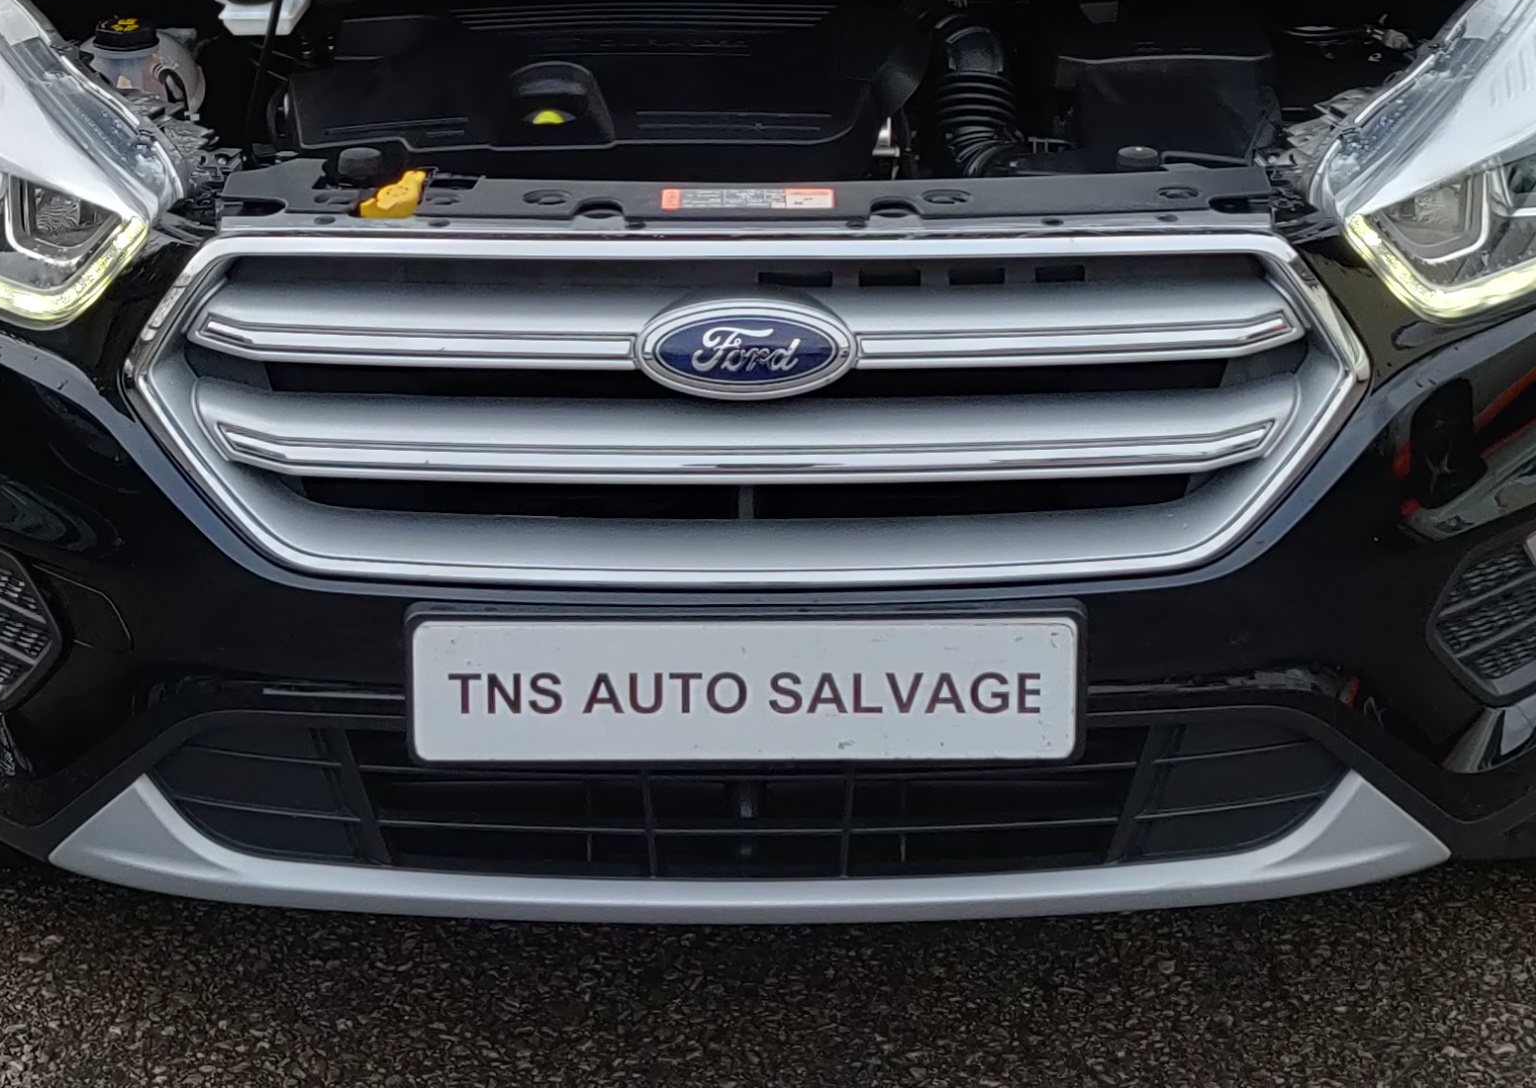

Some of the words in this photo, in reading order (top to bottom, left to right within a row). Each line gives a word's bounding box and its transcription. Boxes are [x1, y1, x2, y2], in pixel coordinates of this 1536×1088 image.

[692, 326, 801, 372] Ford
[448, 671, 563, 715] TNS
[582, 671, 749, 715] AUTO
[768, 671, 1042, 715] SALVAGE
